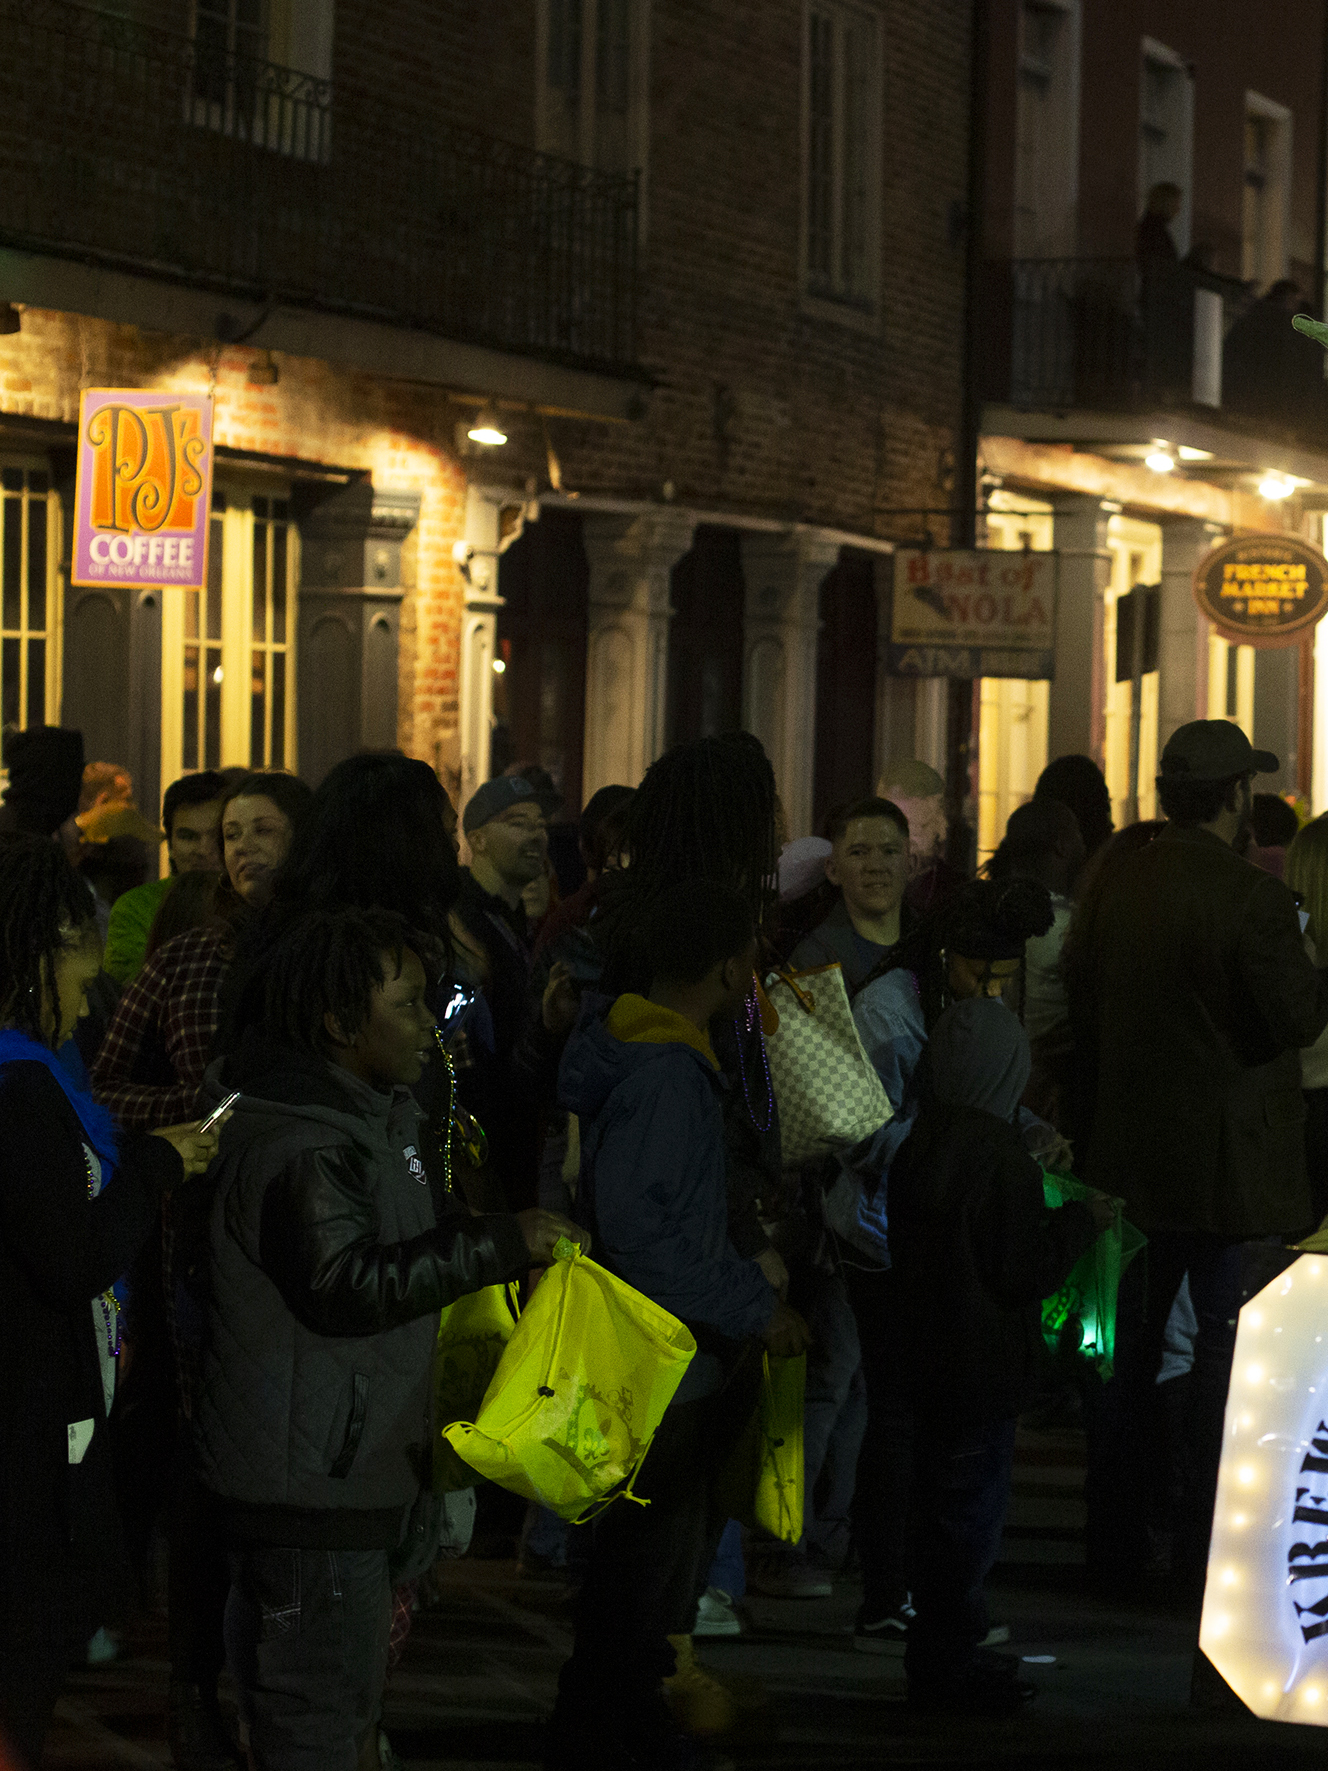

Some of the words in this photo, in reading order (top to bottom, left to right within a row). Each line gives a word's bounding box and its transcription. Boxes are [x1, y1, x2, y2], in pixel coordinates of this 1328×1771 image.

[87, 404, 205, 532] PJ's
[89, 534, 195, 567] COFFEE
[108, 564, 137, 577] NEW
[1223, 563, 1306, 580] FRENCH
[1220, 581, 1309, 599] MARKET
[944, 594, 1048, 626] NOLA
[1248, 600, 1279, 615] INN
